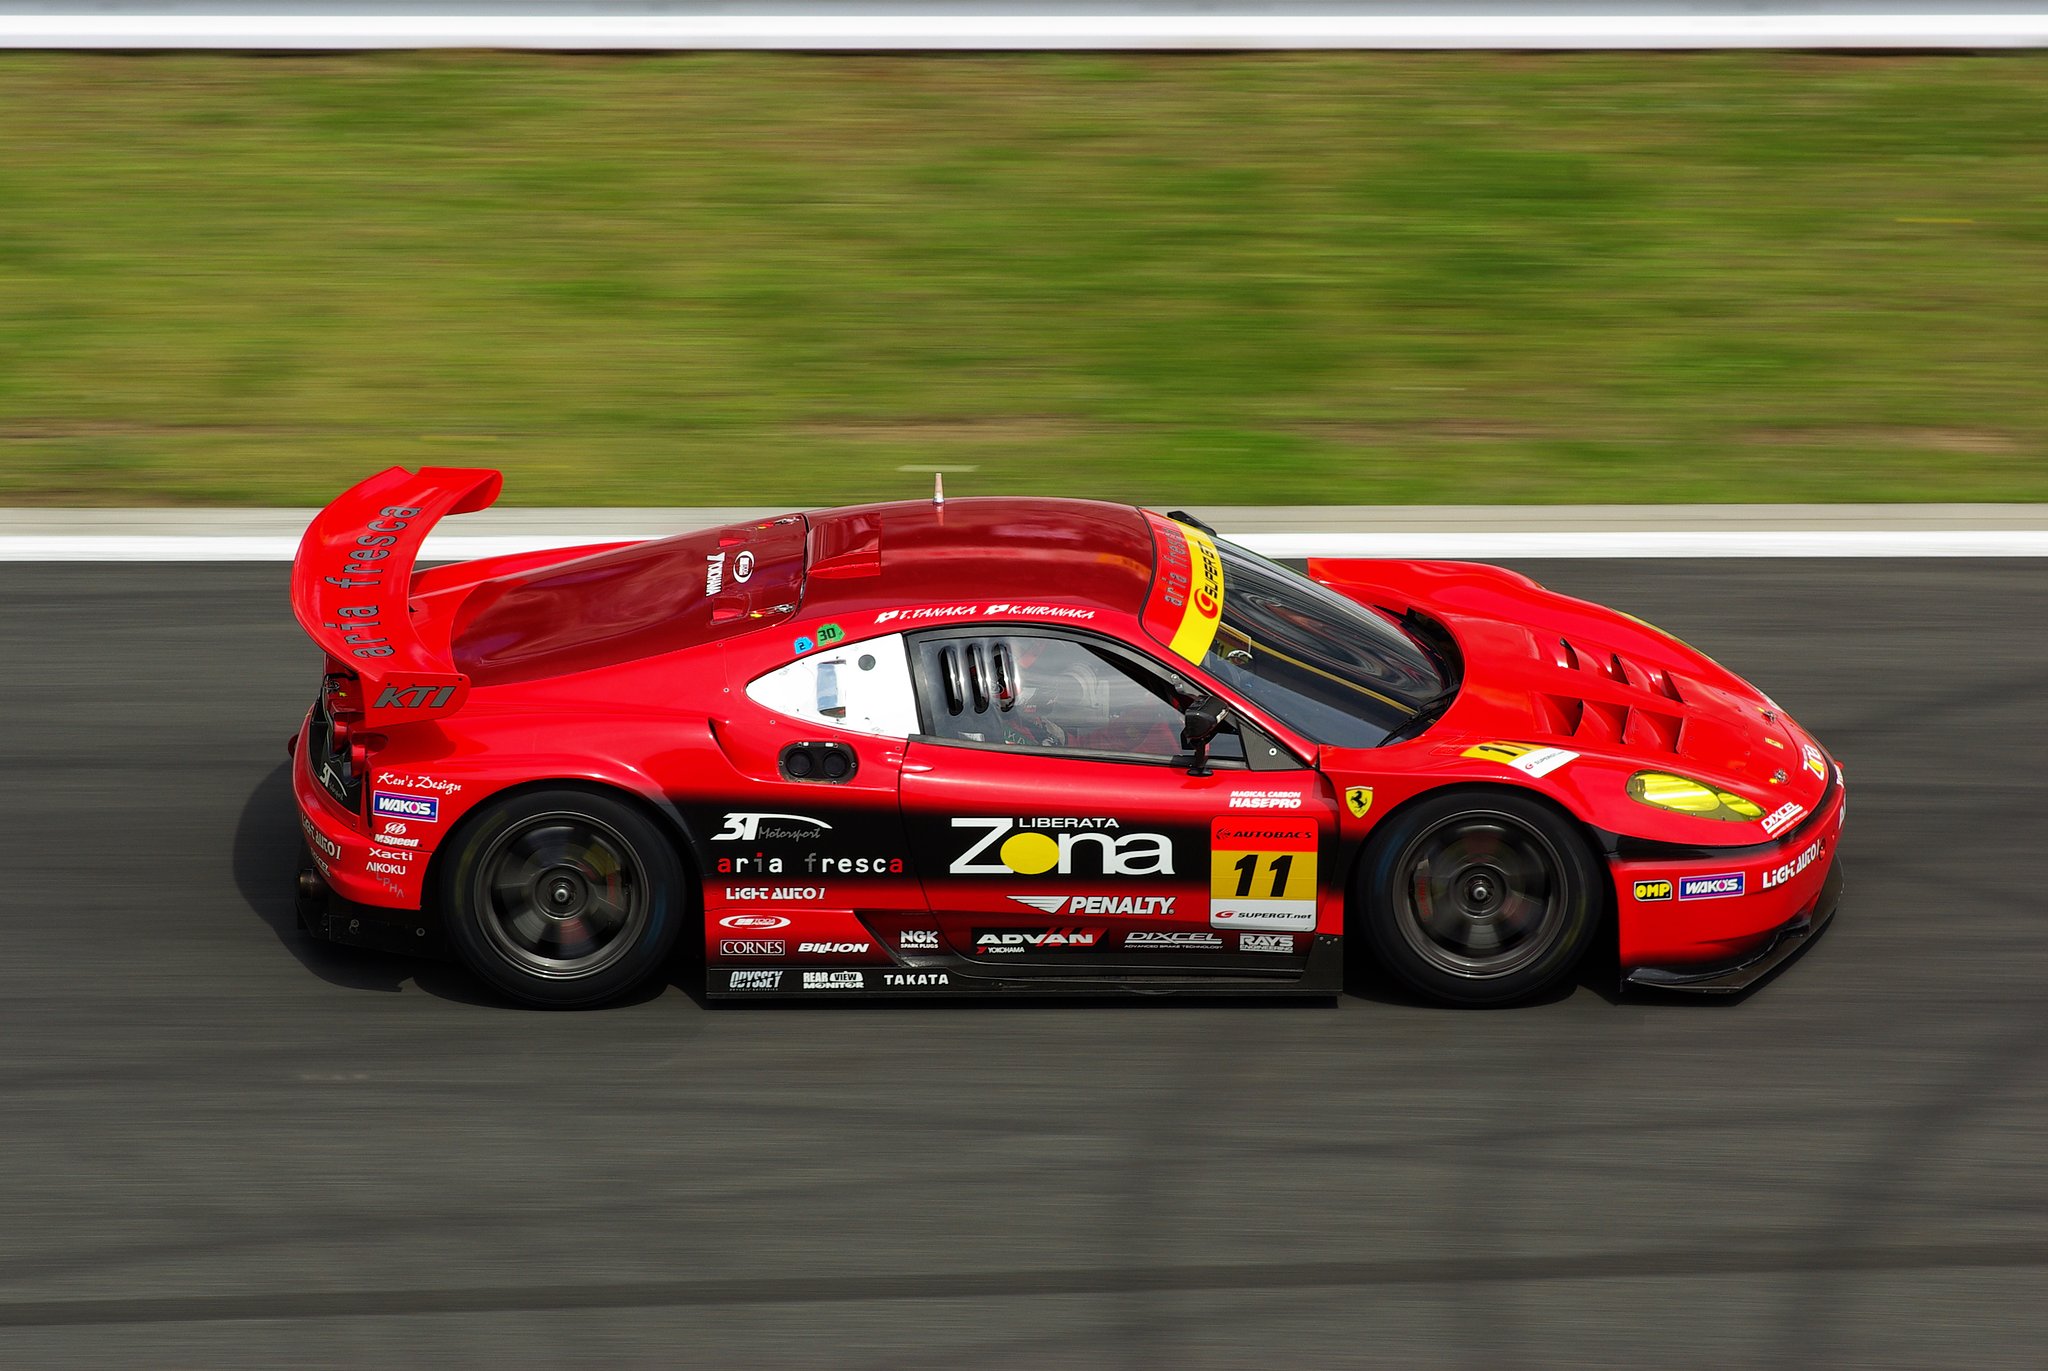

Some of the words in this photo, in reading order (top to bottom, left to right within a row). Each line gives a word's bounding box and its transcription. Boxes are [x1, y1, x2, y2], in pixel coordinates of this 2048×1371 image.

[325, 504, 423, 589] fresca
[1196, 540, 1216, 557] GT
[1201, 555, 1219, 600] SUPER
[1162, 570, 1188, 607] aria
[899, 605, 978, 621] T.TANAKA
[1008, 605, 1095, 620] K.HIRANAKA
[323, 604, 395, 658] aria
[817, 627, 837, 642] 30
[799, 641, 806, 651] 2
[371, 685, 457, 709] KTI
[376, 771, 414, 788] Ken's
[415, 775, 462, 795] Design
[1230, 790, 1266, 798] MAGICAL
[1228, 797, 1302, 809] HASEPRO
[1018, 817, 1120, 828] LIBERATA
[1761, 801, 1801, 831] DIXCEL
[758, 825, 821, 842] Motorsport
[1233, 830, 1312, 839] AUTOBACS
[949, 817, 1176, 876] Zona
[369, 847, 413, 861] Xacti
[366, 861, 406, 876] AIKOKU
[717, 852, 783, 874] aria
[804, 852, 904, 874] fresca
[1233, 854, 1294, 898] 11
[770, 887, 817, 900] AUTO
[1635, 883, 1670, 899] OMP
[1068, 896, 1176, 915] PENALTY
[1237, 911, 1312, 920] SUPERGT.net
[900, 930, 938, 943] NGK
[976, 933, 1094, 945] ADVAN
[1126, 932, 1223, 943] DIXCEL
[1240, 936, 1293, 947] RAYS
[723, 941, 783, 954] CORNES
[798, 942, 869, 954] BILLION
[987, 946, 1025, 954] YOKOHAMA
[729, 970, 784, 988] ODYSSEY
[803, 972, 829, 983] REAR
[834, 972, 857, 982] VIEW
[884, 974, 949, 985] TAKATA
[803, 981, 865, 989] MONITOR
